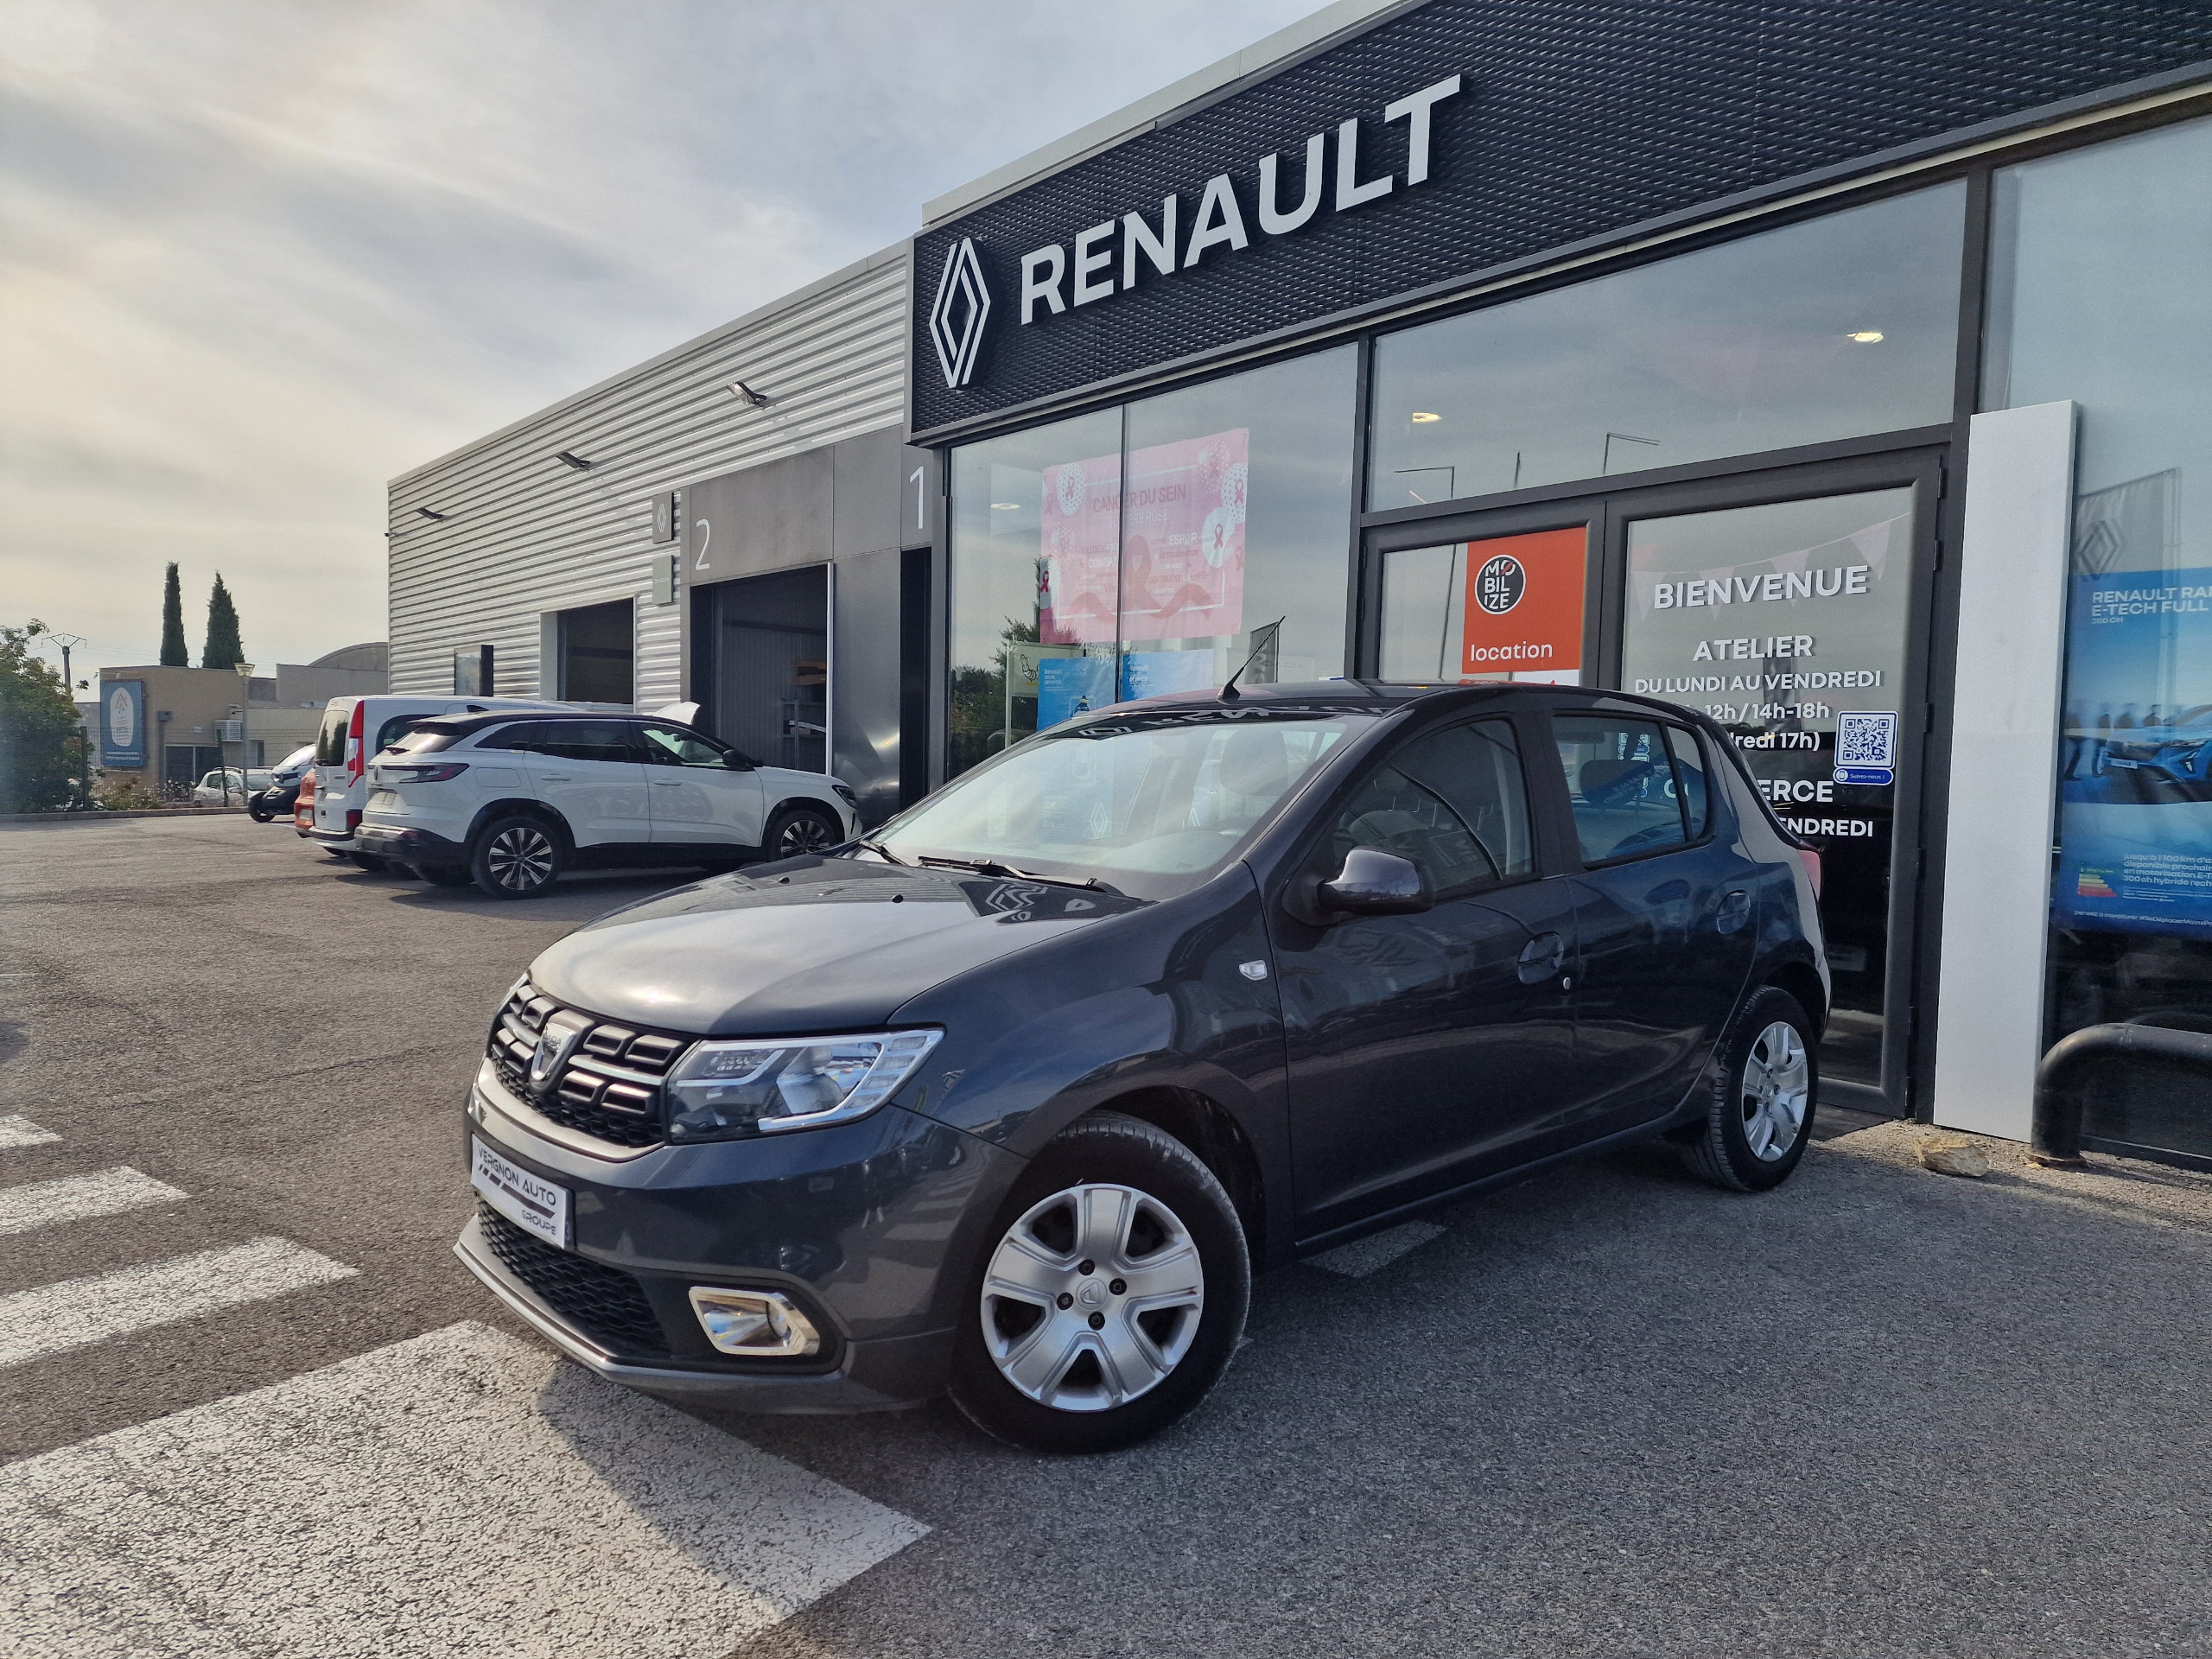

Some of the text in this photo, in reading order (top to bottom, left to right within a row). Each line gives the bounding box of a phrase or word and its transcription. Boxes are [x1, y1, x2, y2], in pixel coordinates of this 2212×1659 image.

[1020, 73, 1462, 326] RENAULT
[910, 466, 925, 530] 1
[1141, 486, 1157, 506] DU
[1159, 482, 1186, 504] SEIN
[695, 518, 711, 570] 2
[1654, 565, 1869, 609] BIENVENUE
[2092, 588, 2177, 604] RENAULT
[2091, 599, 2209, 617] E-TECH FULL
[1471, 640, 1553, 662] location
[1692, 634, 1814, 662] ATELIER
[1635, 671, 1881, 694] DU LUNDI AU VENDREDI
[1752, 701, 1830, 720] 14h-18h
[1780, 731, 1821, 752] 17h)
[2123, 860, 2171, 869] disponible
[2180, 855, 2196, 863] km
[2136, 868, 2196, 879] motorisation
[2153, 876, 2190, 887] hybride
[477, 1143, 557, 1206] VERGNON AUTO
[521, 1210, 556, 1236] GROUPE
